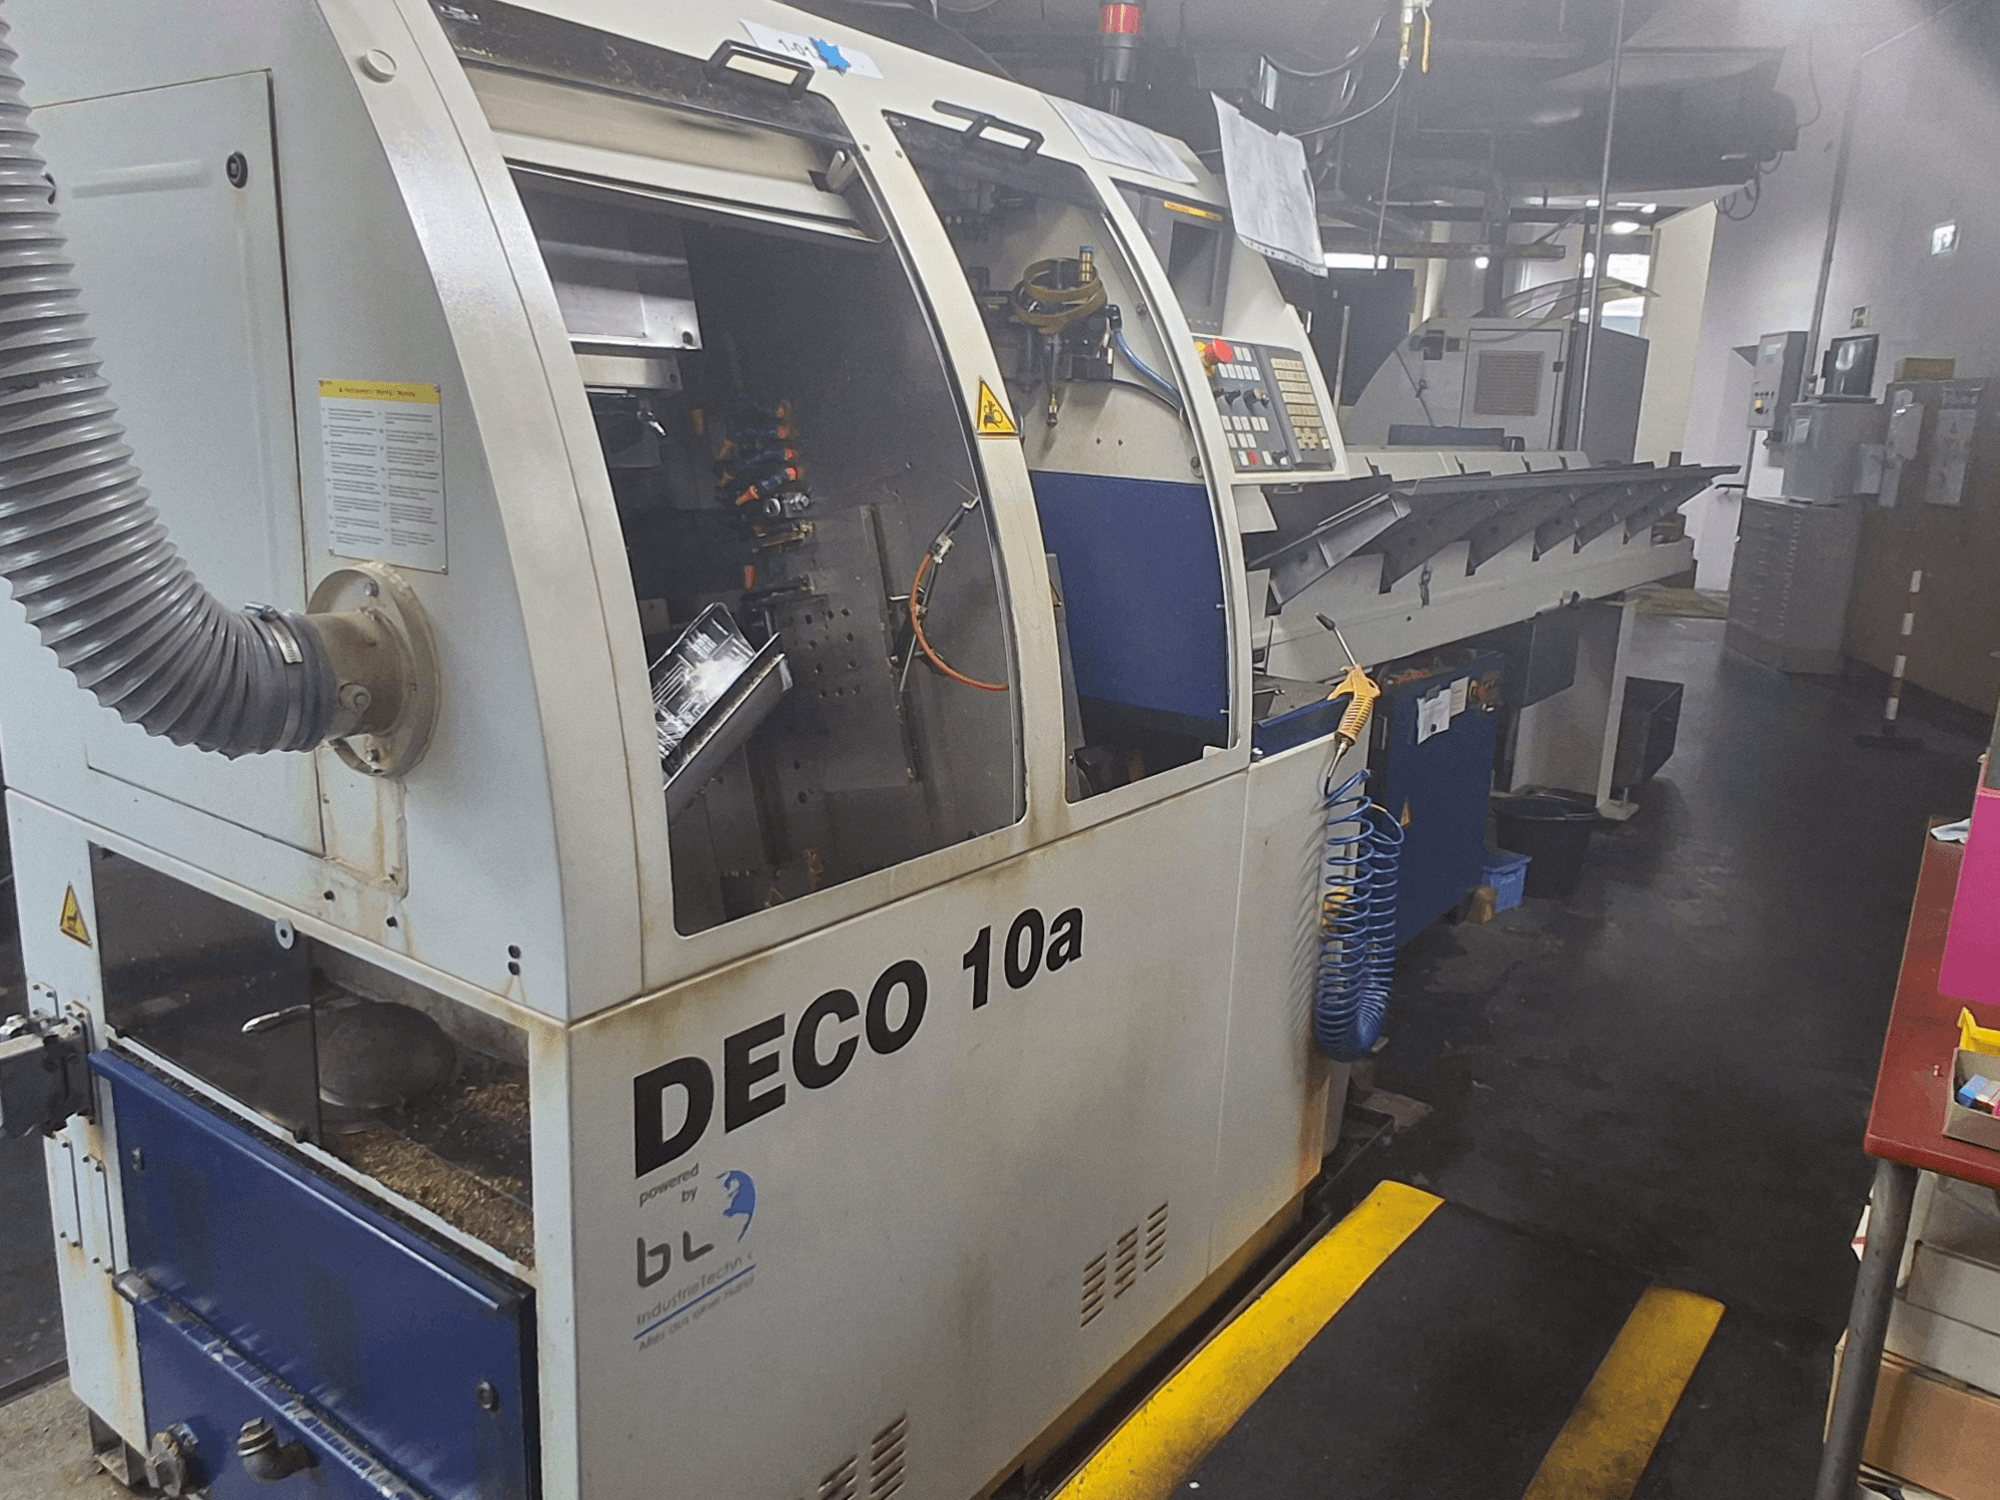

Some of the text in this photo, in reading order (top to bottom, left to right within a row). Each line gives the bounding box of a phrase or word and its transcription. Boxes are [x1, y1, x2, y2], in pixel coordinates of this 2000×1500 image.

[633, 907, 1084, 1179] DECO 10a
[640, 1162, 699, 1208] powered
[682, 1186, 698, 1203] by
